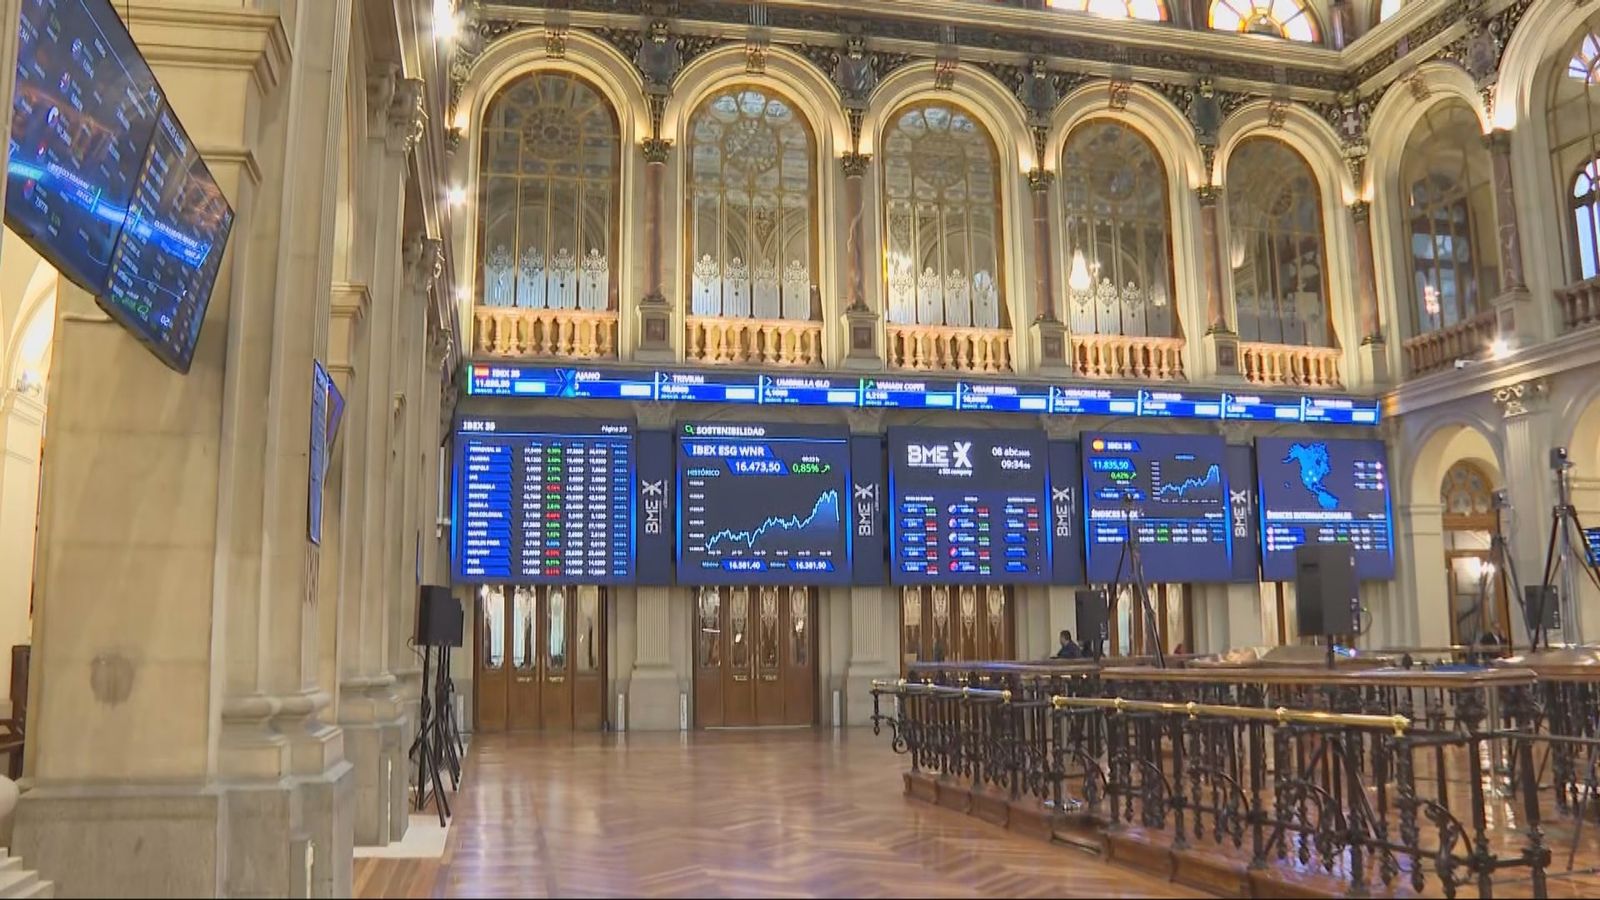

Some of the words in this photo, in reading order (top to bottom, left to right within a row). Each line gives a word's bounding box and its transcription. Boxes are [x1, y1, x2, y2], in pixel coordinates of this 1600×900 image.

[696, 426, 765, 436] SOSTENIBILIDAD
[692, 445, 716, 456] IBEX
[718, 445, 738, 456] ESG
[739, 446, 765, 457] WNR
[907, 444, 949, 464] BME
[735, 461, 780, 473] 16.473,50
[792, 463, 819, 474] 0,85%
[645, 499, 658, 534] BME
[859, 502, 870, 537] BME
[1056, 505, 1069, 537] BME
[1234, 507, 1246, 538] BME
